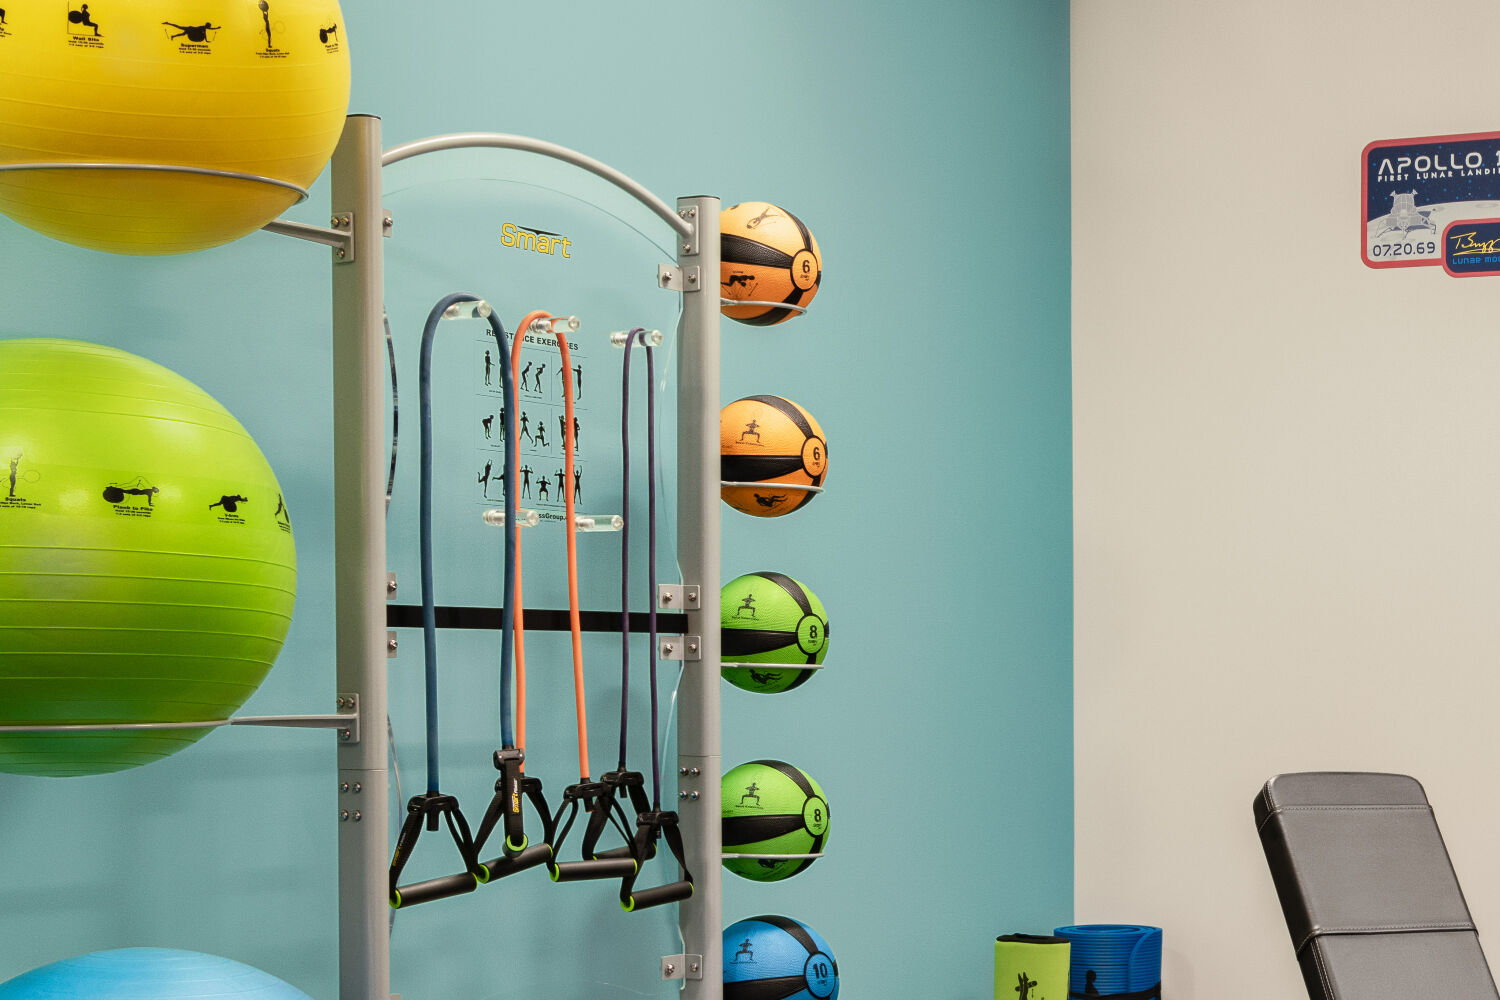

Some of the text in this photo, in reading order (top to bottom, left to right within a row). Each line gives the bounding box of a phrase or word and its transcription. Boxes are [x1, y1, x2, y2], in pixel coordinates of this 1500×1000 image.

[1378, 152, 1483, 175] APOLLO
[1377, 173, 1409, 183] FIRST
[1416, 171, 1453, 180] LUNAR
[500, 222, 573, 259] Smart
[1372, 241, 1436, 257] 07.20.69
[802, 260, 811, 274] 6
[813, 446, 821, 461] 6
[809, 624, 818, 639] 8
[814, 808, 822, 823] 8
[813, 962, 828, 979] 10
